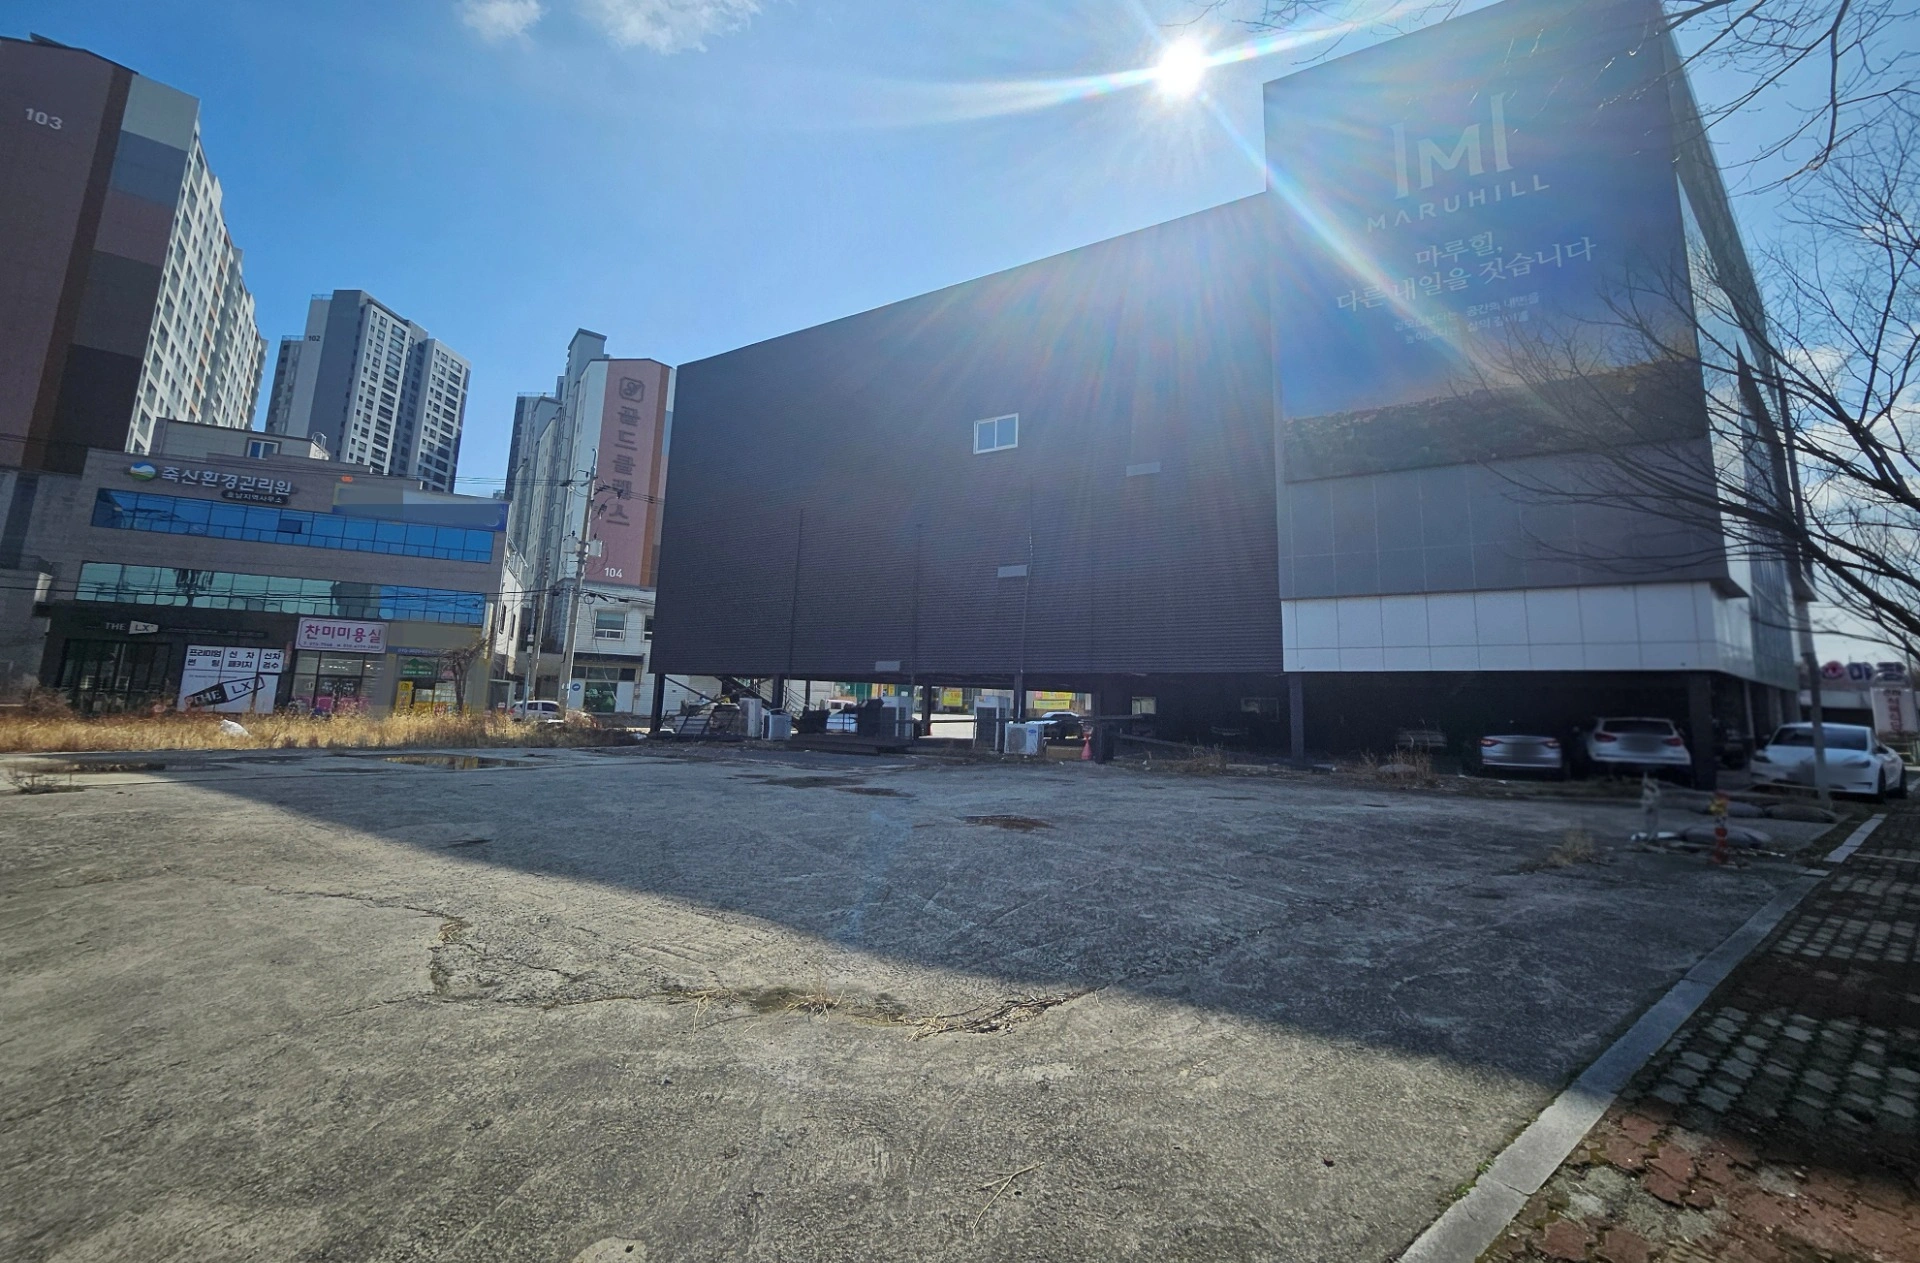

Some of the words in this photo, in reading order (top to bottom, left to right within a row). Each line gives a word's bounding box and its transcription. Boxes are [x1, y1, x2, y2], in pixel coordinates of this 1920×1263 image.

[25, 108, 62, 130] 103
[1367, 174, 1550, 233] MARUHILL
[1415, 232, 1503, 267] 마루힐,
[1336, 285, 1388, 312] 다른
[1392, 267, 1472, 300] 내일을
[1479, 237, 1598, 284] 짓습니다
[161, 466, 292, 496] 축산환경관리원
[604, 567, 623, 578] 104
[105, 622, 127, 631] THE
[304, 624, 382, 644] 찬미미용실
[231, 681, 252, 694] LX
